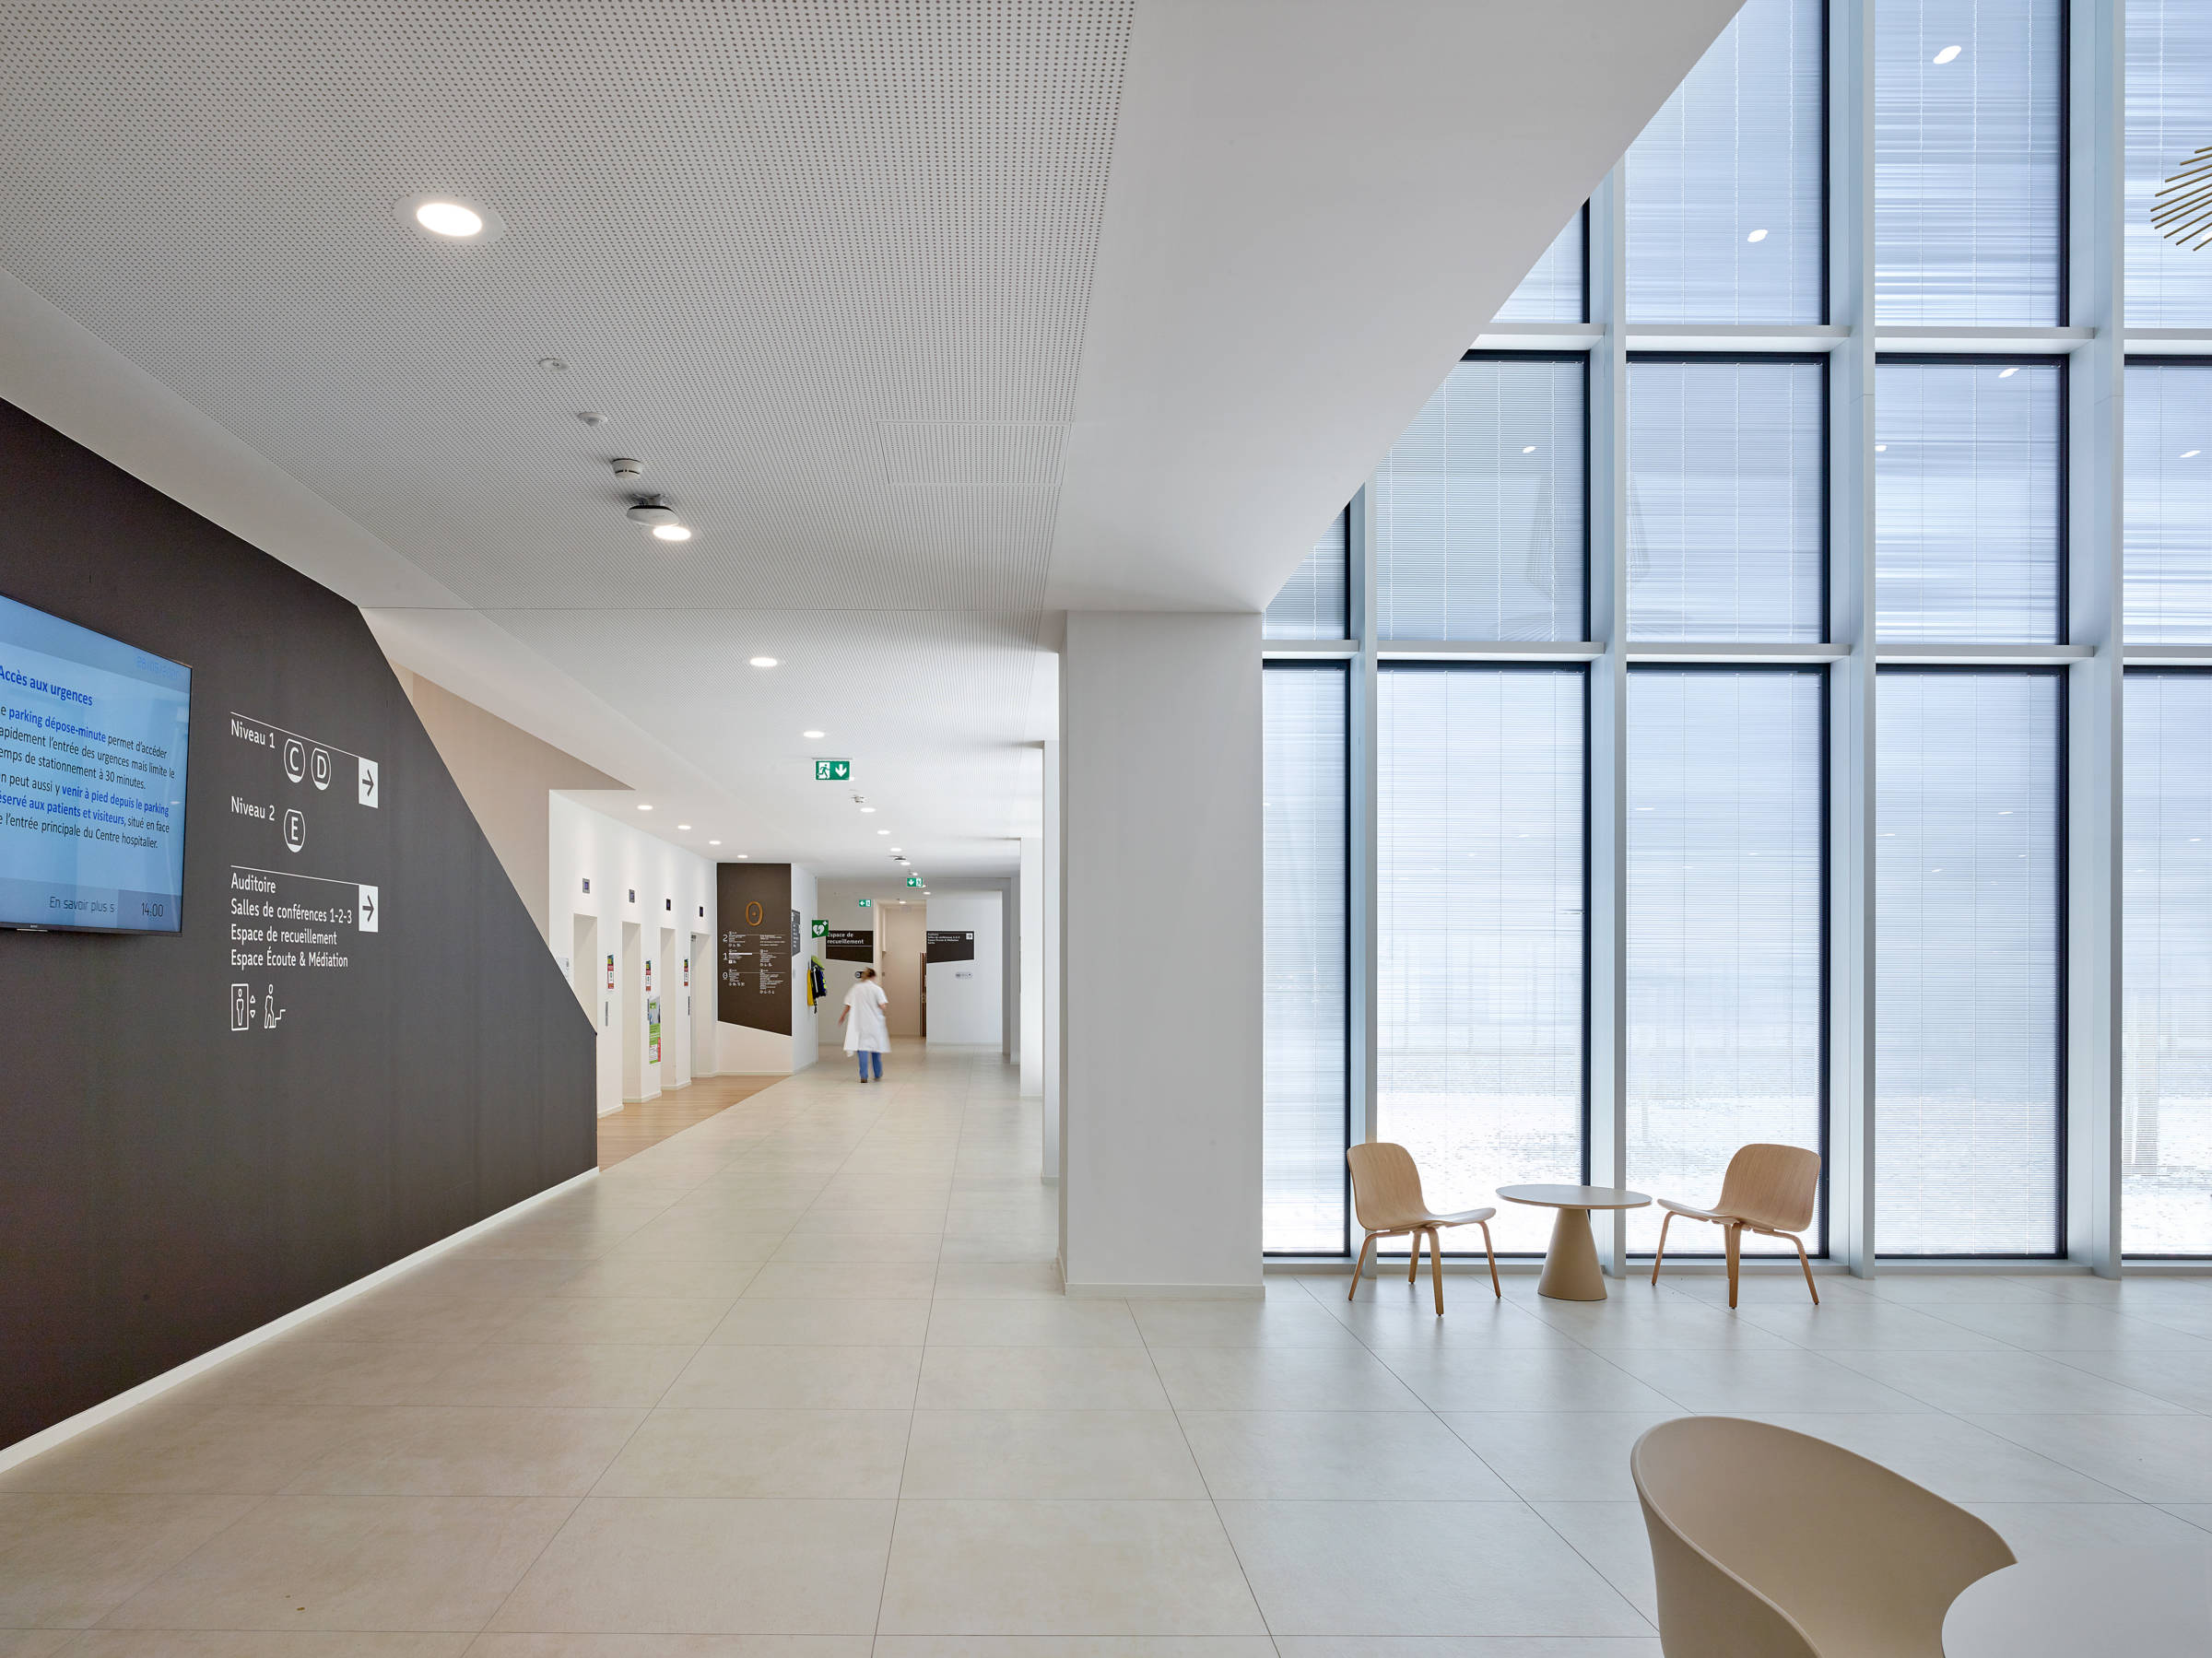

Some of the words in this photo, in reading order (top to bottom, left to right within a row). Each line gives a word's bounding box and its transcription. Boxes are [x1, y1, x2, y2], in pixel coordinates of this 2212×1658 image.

[0, 665, 28, 686] Accès
[29, 678, 48, 692] aux
[50, 684, 93, 706] urgences
[8, 708, 42, 728] parking
[44, 716, 106, 742] dépose-minute
[108, 735, 134, 750] permet
[135, 742, 167, 758] d'accéder
[231, 718, 265, 746] Niveau
[269, 732, 276, 749] 1
[289, 747, 300, 771] C
[317, 755, 326, 779] D
[0, 727, 46, 747] apidement
[49, 735, 79, 755] l'entrée
[81, 746, 95, 759] des
[97, 751, 129, 767] urgences
[131, 759, 147, 772] mais
[148, 761, 167, 778] limite
[169, 767, 175, 779] le
[0, 747, 22, 763] emps
[25, 752, 36, 765] de
[38, 756, 97, 779] stationnement
[99, 769, 104, 781] à
[105, 770, 115, 782] 30
[116, 774, 146, 790] minutes.
[0, 790, 27, 807] servé
[29, 799, 45, 811] aux
[47, 802, 81, 817] patients
[83, 808, 91, 819] et
[92, 810, 126, 827] visiteurs,
[127, 817, 145, 829] situé
[146, 821, 155, 830] en
[156, 820, 170, 833] face
[9, 775, 29, 787] peut
[31, 780, 53, 793] aussi
[54, 783, 61, 796] y
[62, 785, 83, 797] venir
[84, 788, 89, 799] à
[91, 790, 108, 803] pied
[111, 794, 134, 808] depuis
[135, 799, 143, 810] le
[144, 802, 169, 817] parking
[6, 812, 39, 830] l'entrée
[41, 821, 81, 837] principale
[83, 827, 93, 839] du
[95, 829, 120, 843] Centre
[122, 833, 159, 849] hospitalier.
[231, 795, 265, 820] Niveau
[268, 805, 276, 821] 2
[291, 817, 299, 841] E
[231, 872, 276, 894] Auditoire
[49, 896, 61, 909] En
[63, 900, 89, 911] savoir
[90, 900, 108, 913] plus
[141, 901, 164, 917] 14:00
[230, 898, 260, 916] Salles
[263, 900, 274, 918] de
[276, 903, 327, 922] conférences
[329, 908, 352, 923] 1-2-3
[231, 923, 264, 946] Espace
[266, 925, 277, 942] de
[280, 928, 337, 945] recueillement
[723, 934, 728, 942] 2
[231, 948, 264, 970] Espace
[266, 946, 297, 966] Écoute
[299, 951, 306, 966] &
[308, 951, 348, 967] Médiation
